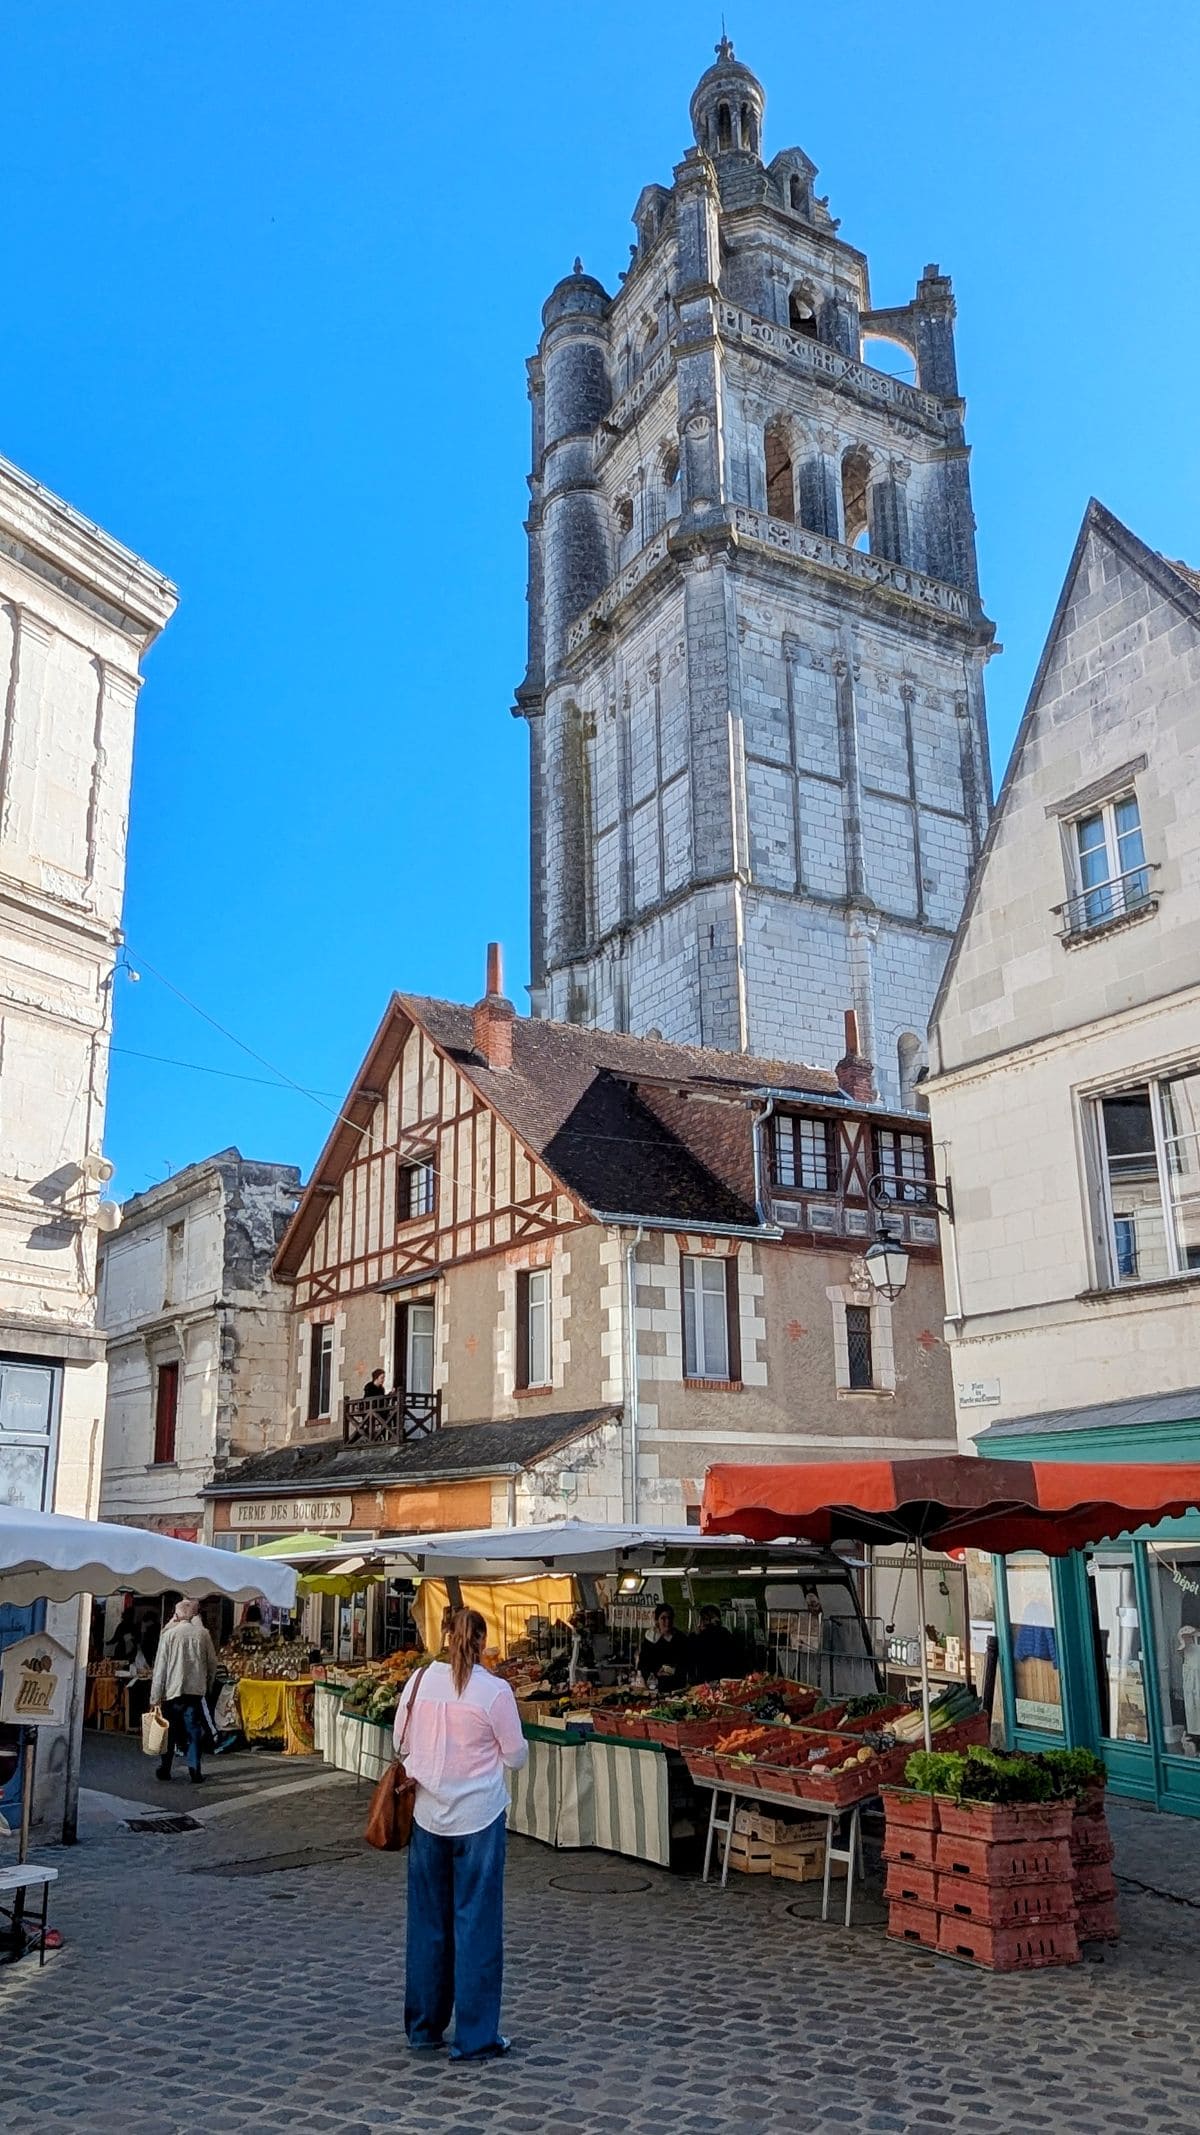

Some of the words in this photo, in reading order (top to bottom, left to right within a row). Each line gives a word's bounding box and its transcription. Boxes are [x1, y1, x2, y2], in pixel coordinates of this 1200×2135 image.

[238, 1505, 266, 1521] FERME
[271, 1504, 288, 1520] DES
[293, 1502, 341, 1520] BOUQUETS
[17, 1680, 53, 1707] Miel
